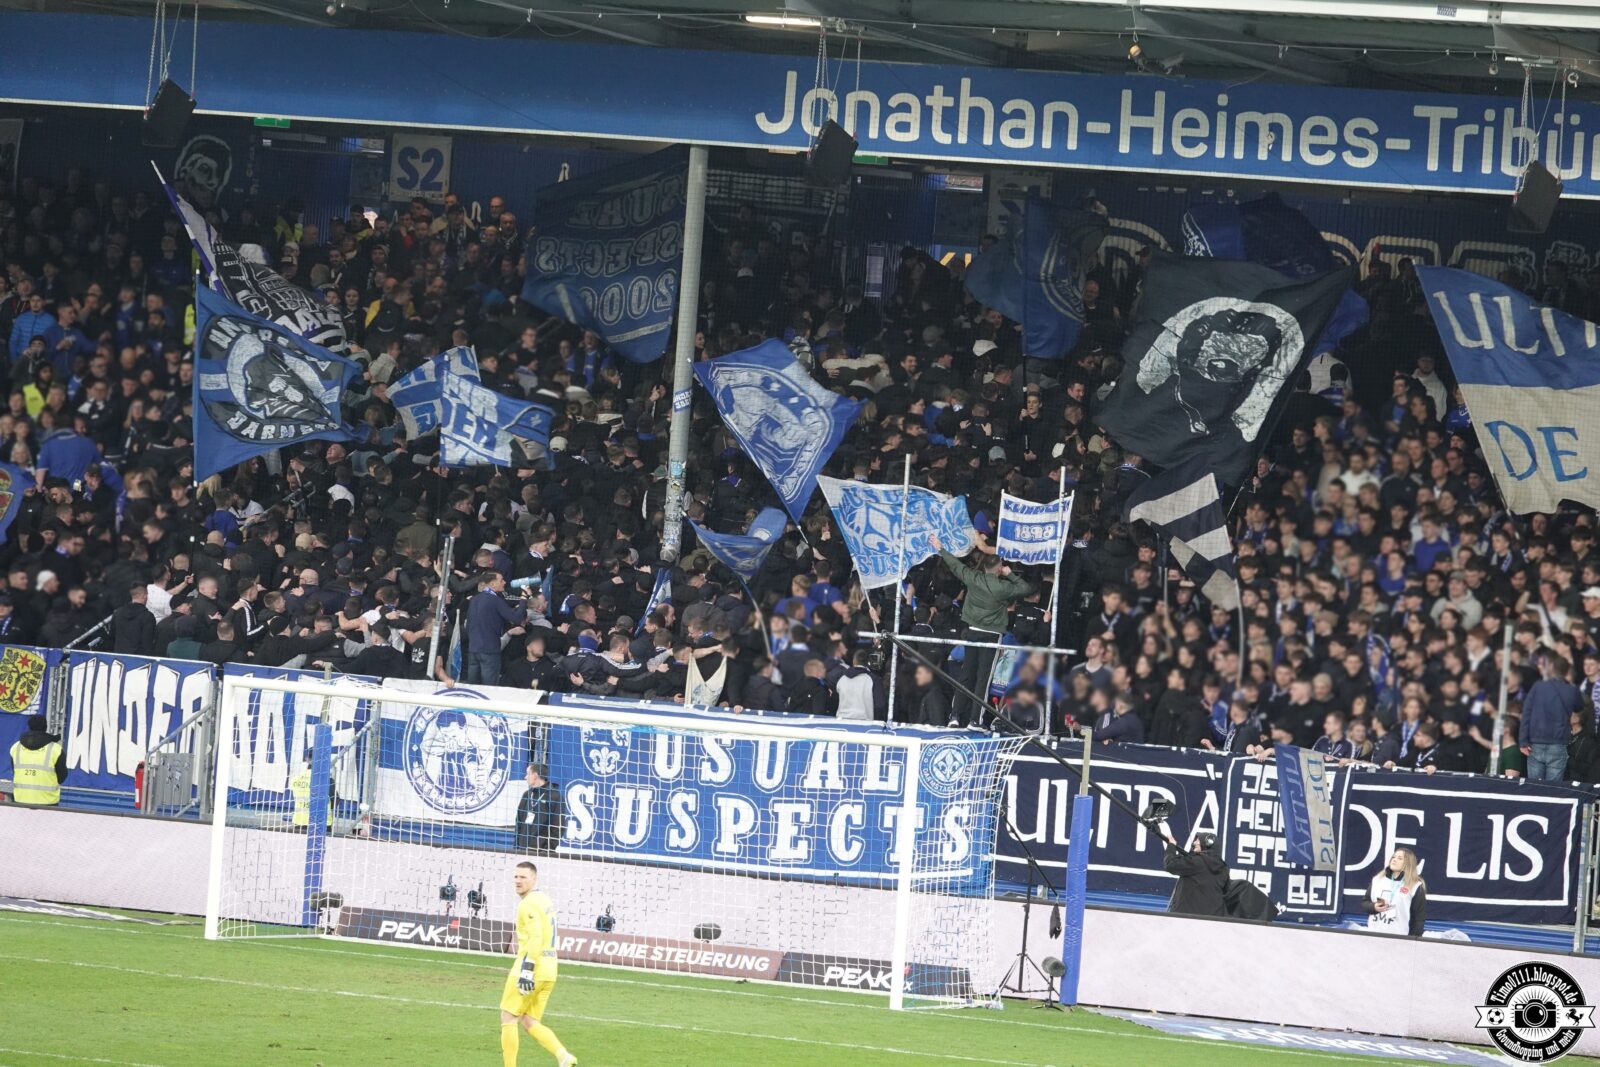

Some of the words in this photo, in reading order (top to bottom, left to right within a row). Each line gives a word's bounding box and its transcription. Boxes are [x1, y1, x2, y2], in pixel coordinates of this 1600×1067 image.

[755, 70, 1600, 181] Jonathan-Heimes-Tribü
[396, 146, 444, 192] S2
[1484, 420, 1588, 483] DE
[1014, 523, 1056, 541] 1898
[653, 731, 902, 794] USUAL
[566, 781, 972, 866] SUSPECTS
[1444, 812, 1549, 882] LIS
[1287, 874, 1333, 906] BEI
[377, 920, 448, 943] PEAK
[589, 941, 648, 959] HOME
[650, 945, 770, 972] STEUERUNG
